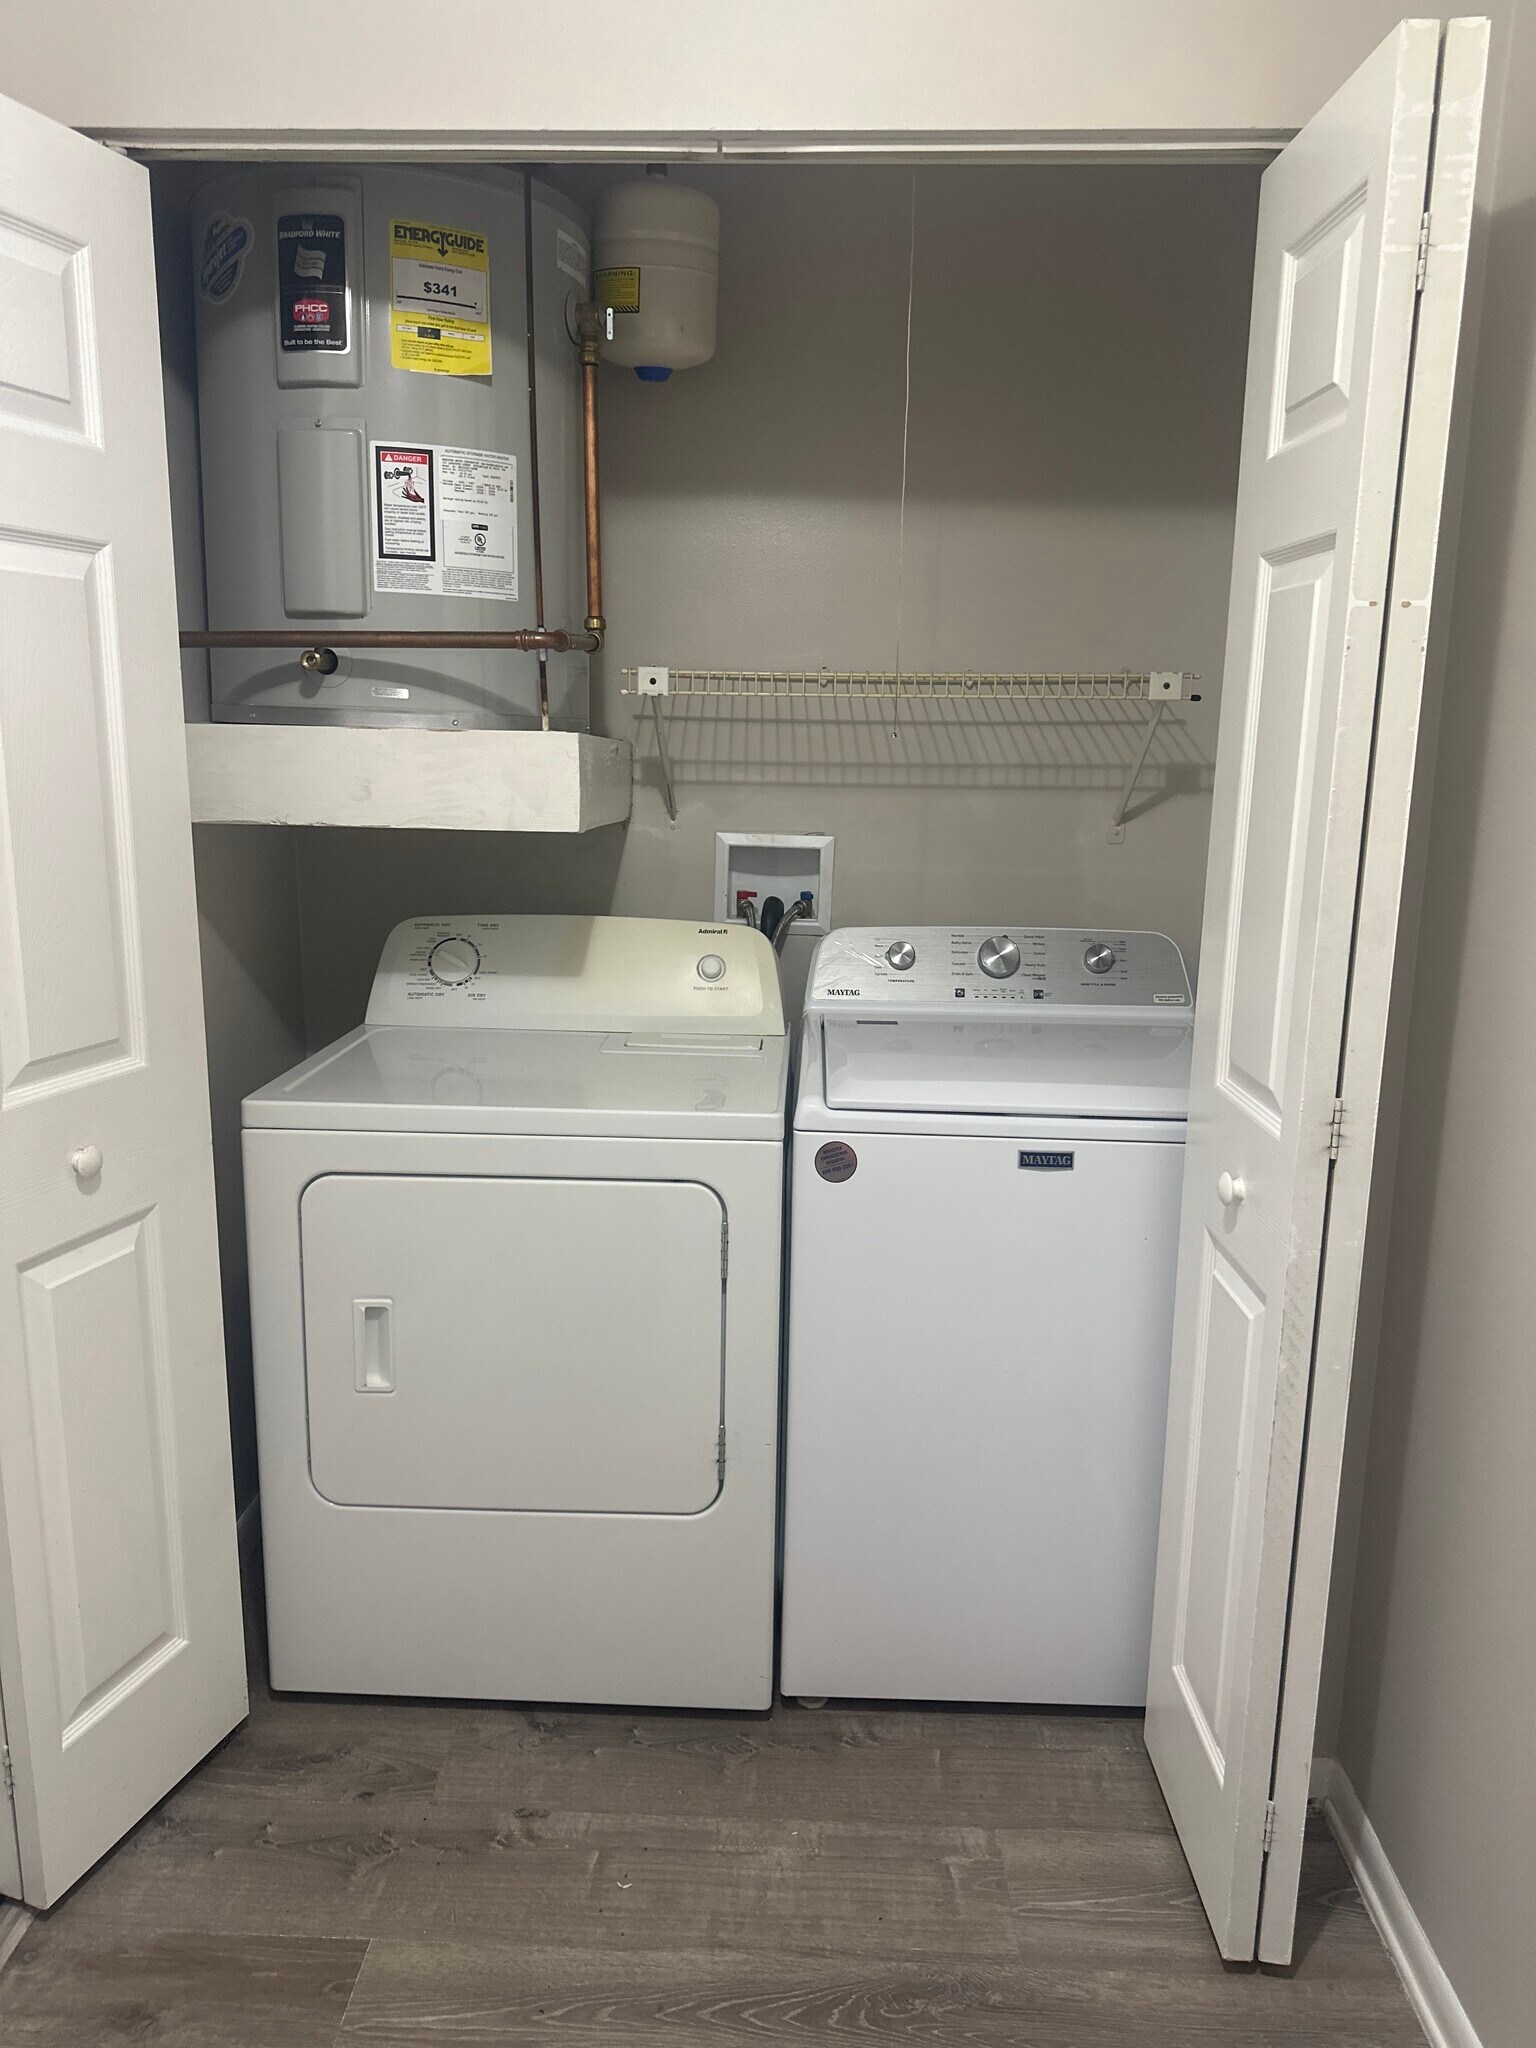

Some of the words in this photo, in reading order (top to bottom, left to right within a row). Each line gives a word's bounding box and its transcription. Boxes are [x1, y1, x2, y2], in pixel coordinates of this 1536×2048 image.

[279, 230, 314, 240] BRADFORD
[315, 229, 342, 238] WHITE
[394, 224, 485, 255] ENERGYGUIDE
[423, 281, 457, 298] $341
[294, 304, 328, 312] PHCC
[394, 455, 422, 463] DANGER
[1022, 1155, 1071, 1165] MAYTAG
